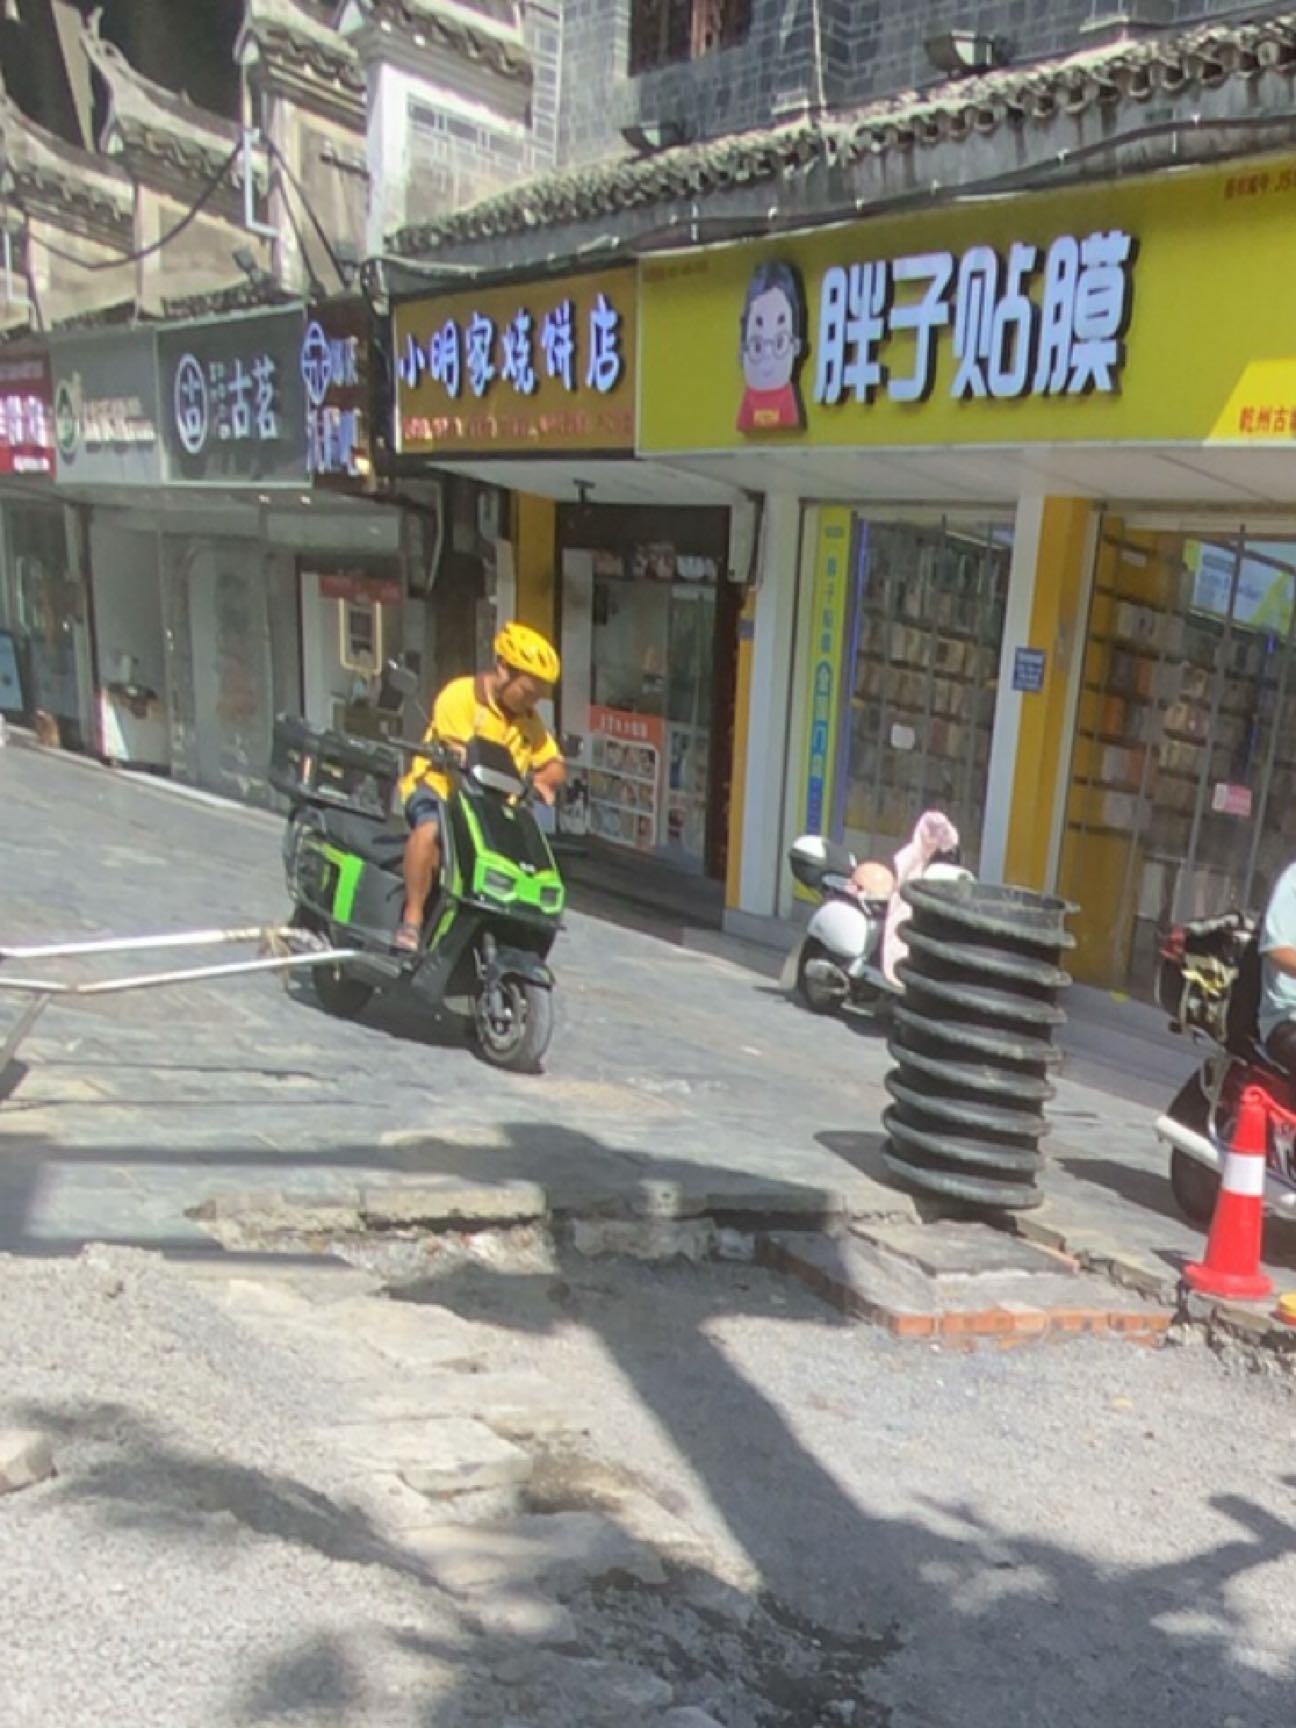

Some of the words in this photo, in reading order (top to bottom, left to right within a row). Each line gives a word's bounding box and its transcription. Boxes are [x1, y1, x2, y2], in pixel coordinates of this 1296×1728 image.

[400, 292, 621, 399] 小明家烧饼店
[813, 230, 1134, 405] 胖子贴膜
[229, 353, 279, 440] 古茗
